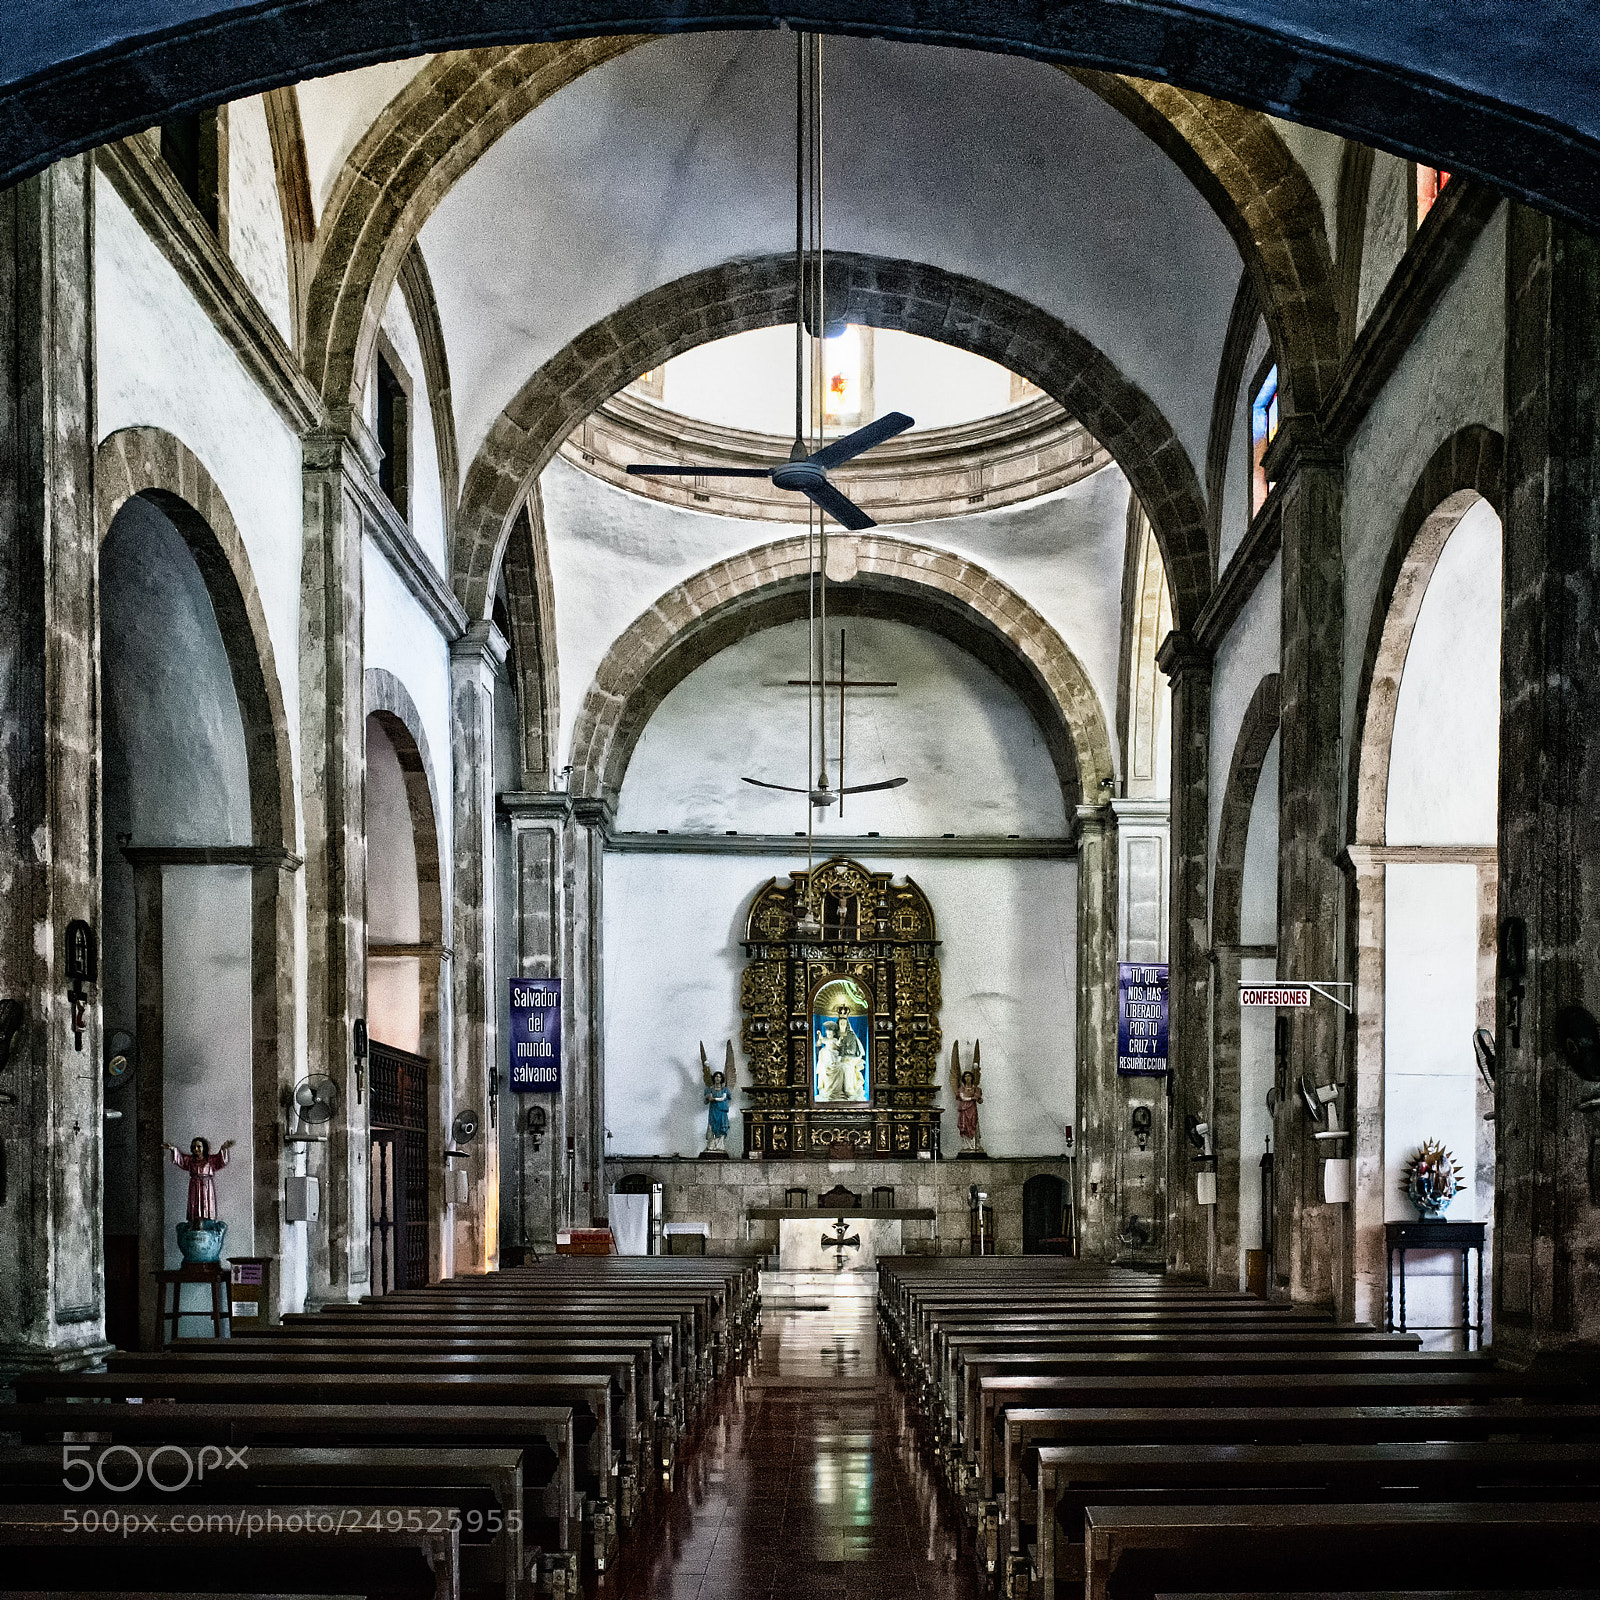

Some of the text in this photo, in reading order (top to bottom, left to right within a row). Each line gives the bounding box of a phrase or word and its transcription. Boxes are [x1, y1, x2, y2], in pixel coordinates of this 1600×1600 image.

[1144, 969, 1159, 985] QUE
[514, 987, 558, 1007] Salvador
[1127, 985, 1162, 1002] NOS HAS
[1242, 990, 1307, 1004] CONFESIONES
[528, 1012, 544, 1032] del
[1129, 1021, 1158, 1036] POR TU
[1128, 1038, 1158, 1054] CRUZ Y
[513, 1062, 557, 1083] sálvanos
